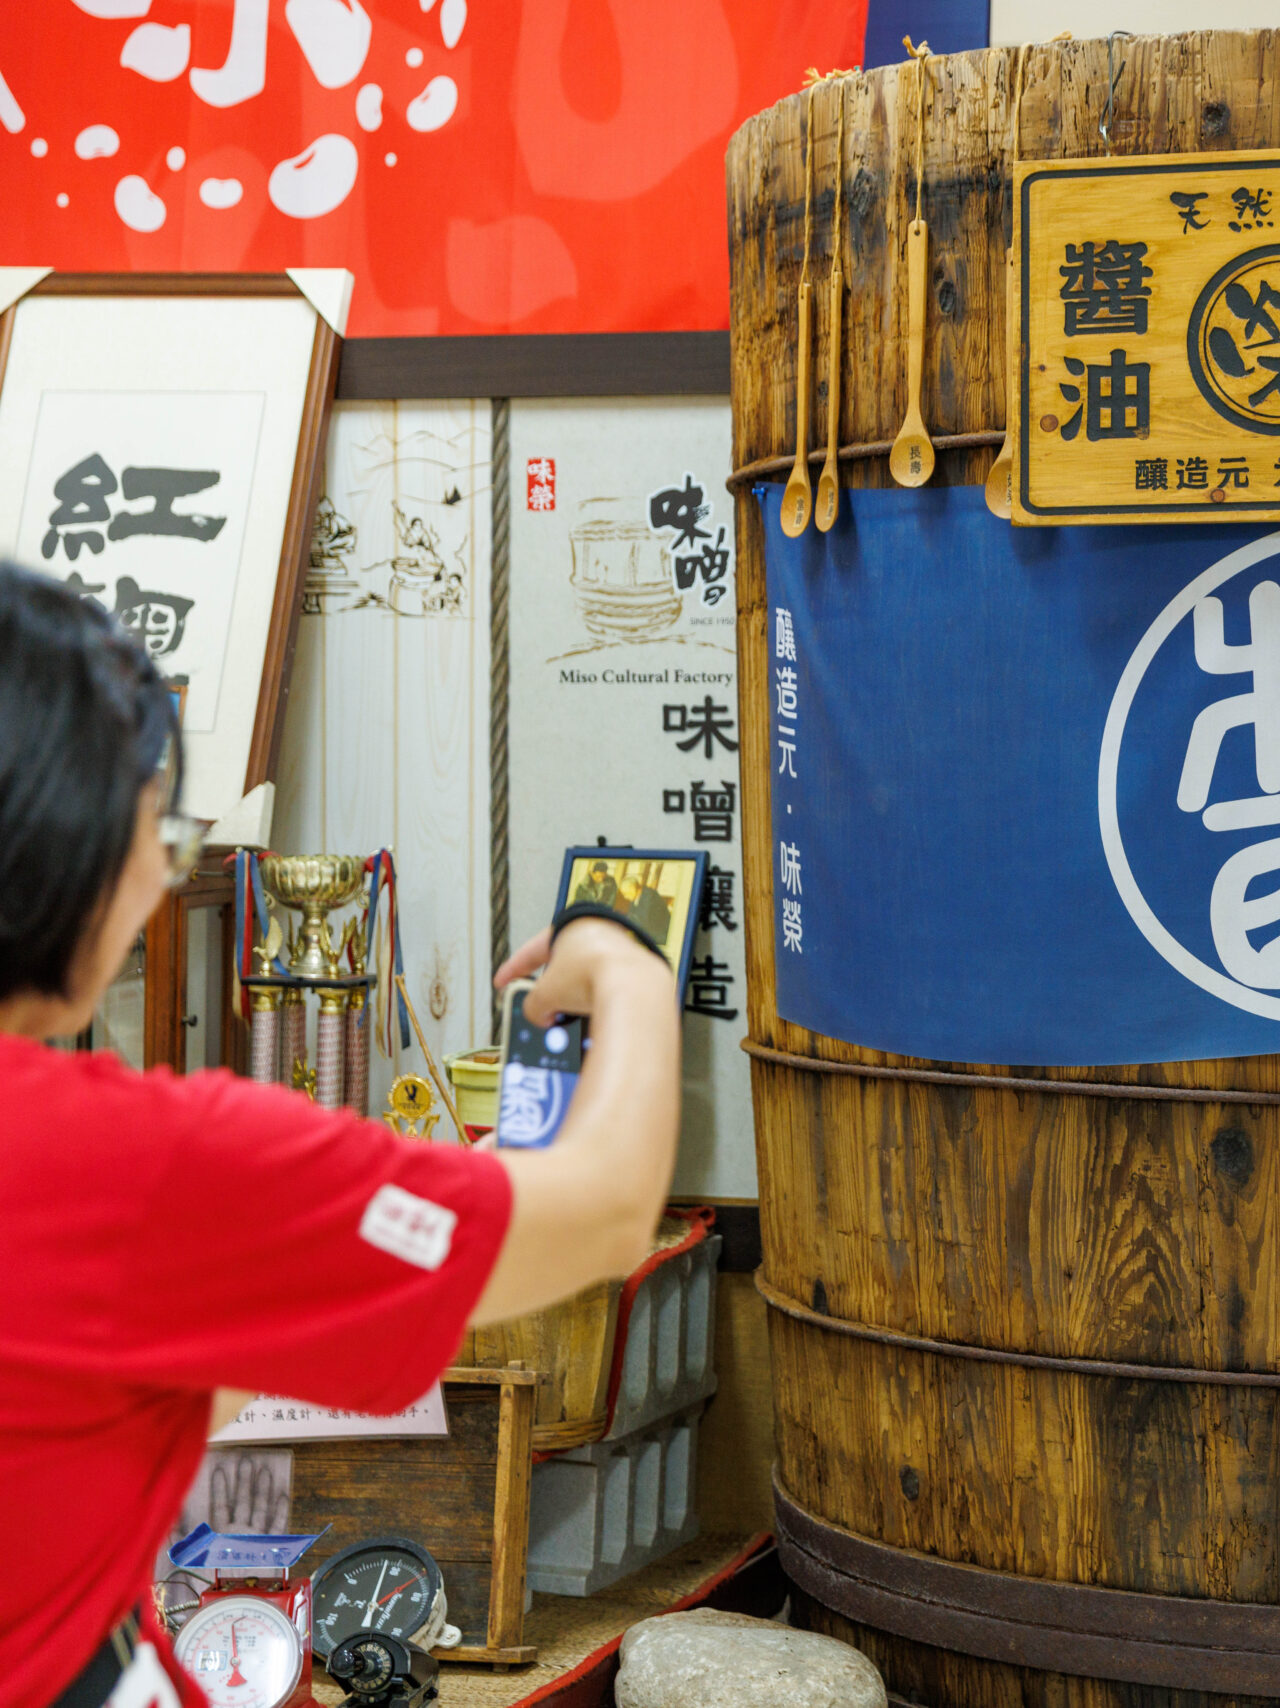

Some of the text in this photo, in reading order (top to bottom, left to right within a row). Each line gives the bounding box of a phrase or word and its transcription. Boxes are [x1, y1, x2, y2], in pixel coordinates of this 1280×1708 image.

[1059, 240, 1153, 442] 醬油
[528, 458, 556, 511] 味榮
[1134, 455, 1250, 491] 釀造元
[690, 616, 713, 625] SINCE
[559, 669, 734, 687] Miso Cultural Factory
